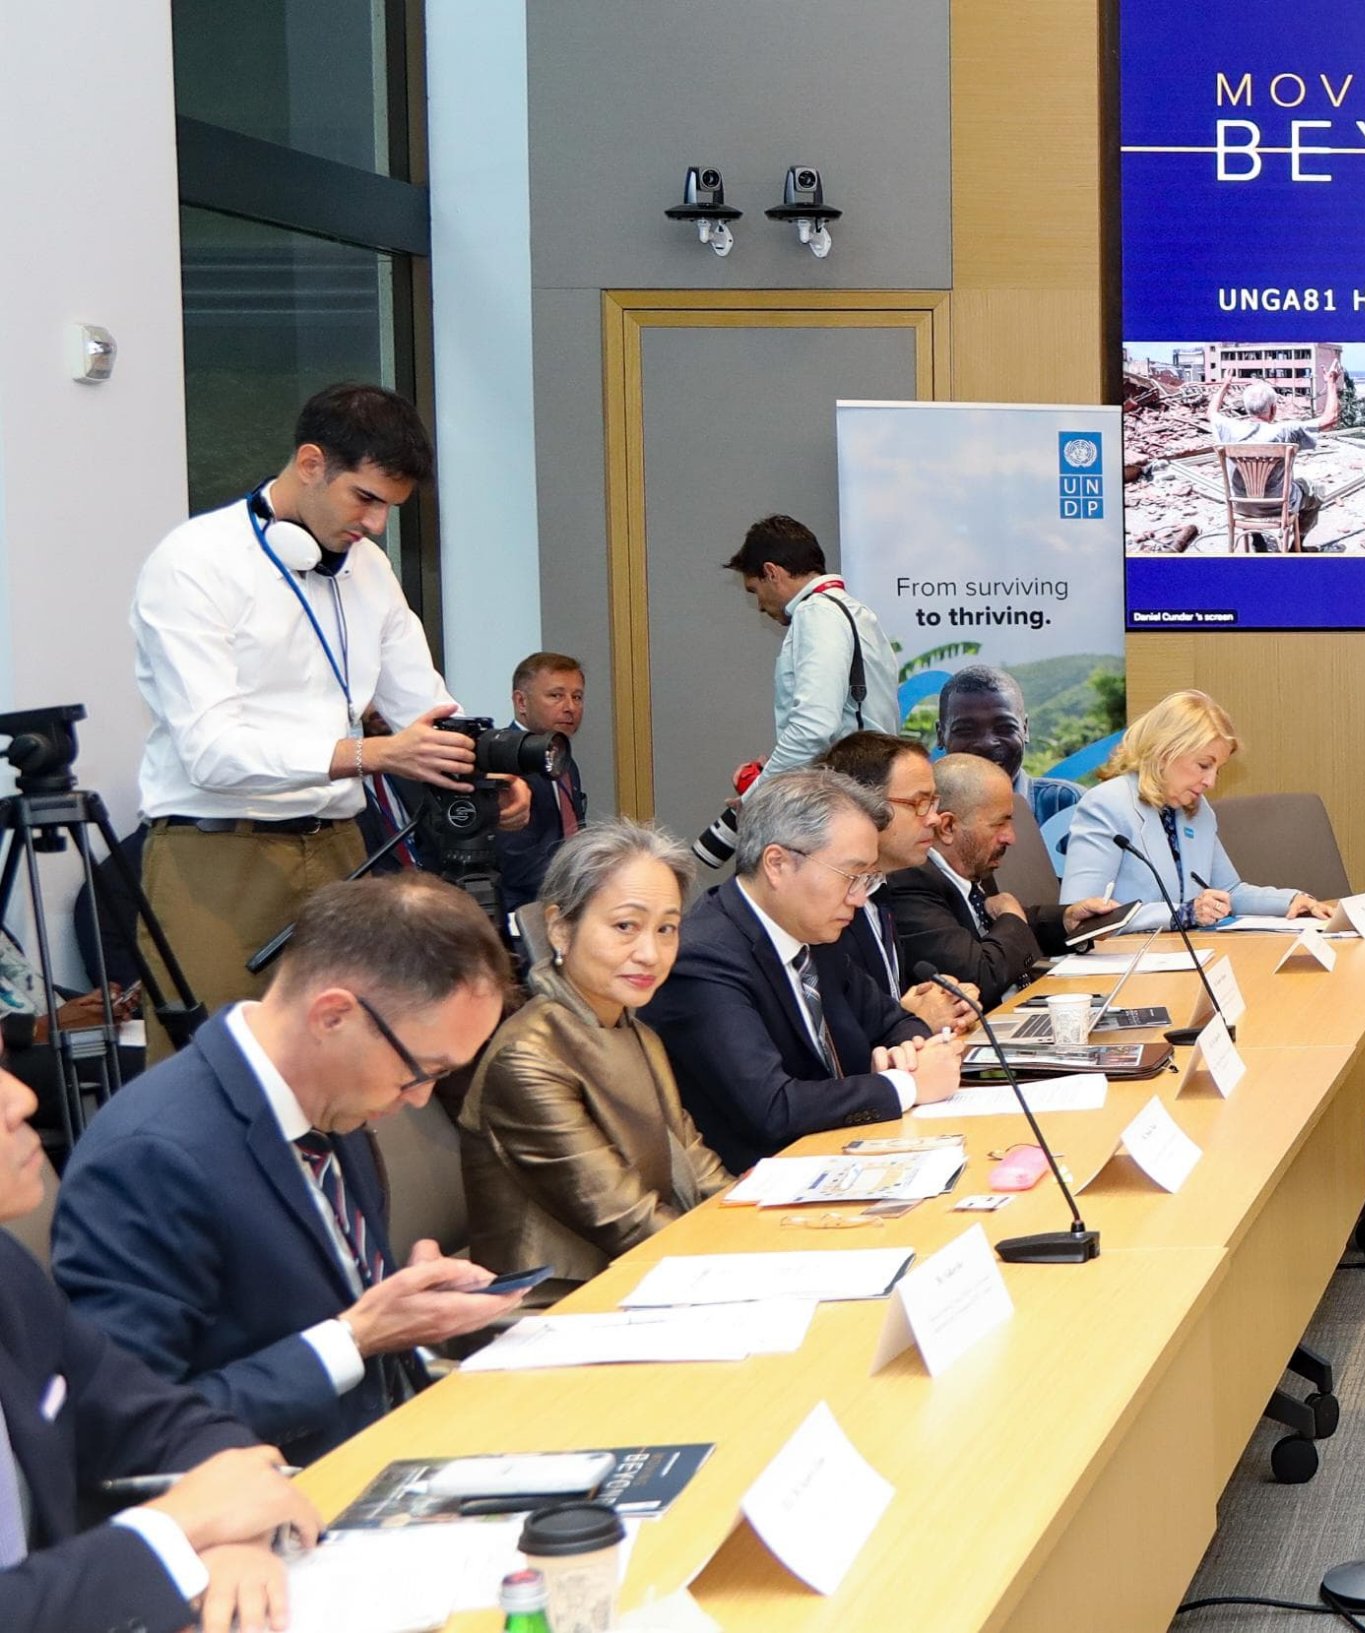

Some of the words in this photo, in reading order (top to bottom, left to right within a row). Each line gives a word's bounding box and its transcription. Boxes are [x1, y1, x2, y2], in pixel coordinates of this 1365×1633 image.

[1218, 288, 1338, 312] UNGA81
[1063, 478, 1099, 495] UN
[1064, 500, 1099, 517] DP
[897, 577, 957, 597] From
[965, 579, 1069, 601] surviving
[915, 608, 941, 627] to
[948, 605, 1052, 630] thriving.
[1133, 611, 1161, 621] Daniel
[1204, 613, 1234, 621] screen
